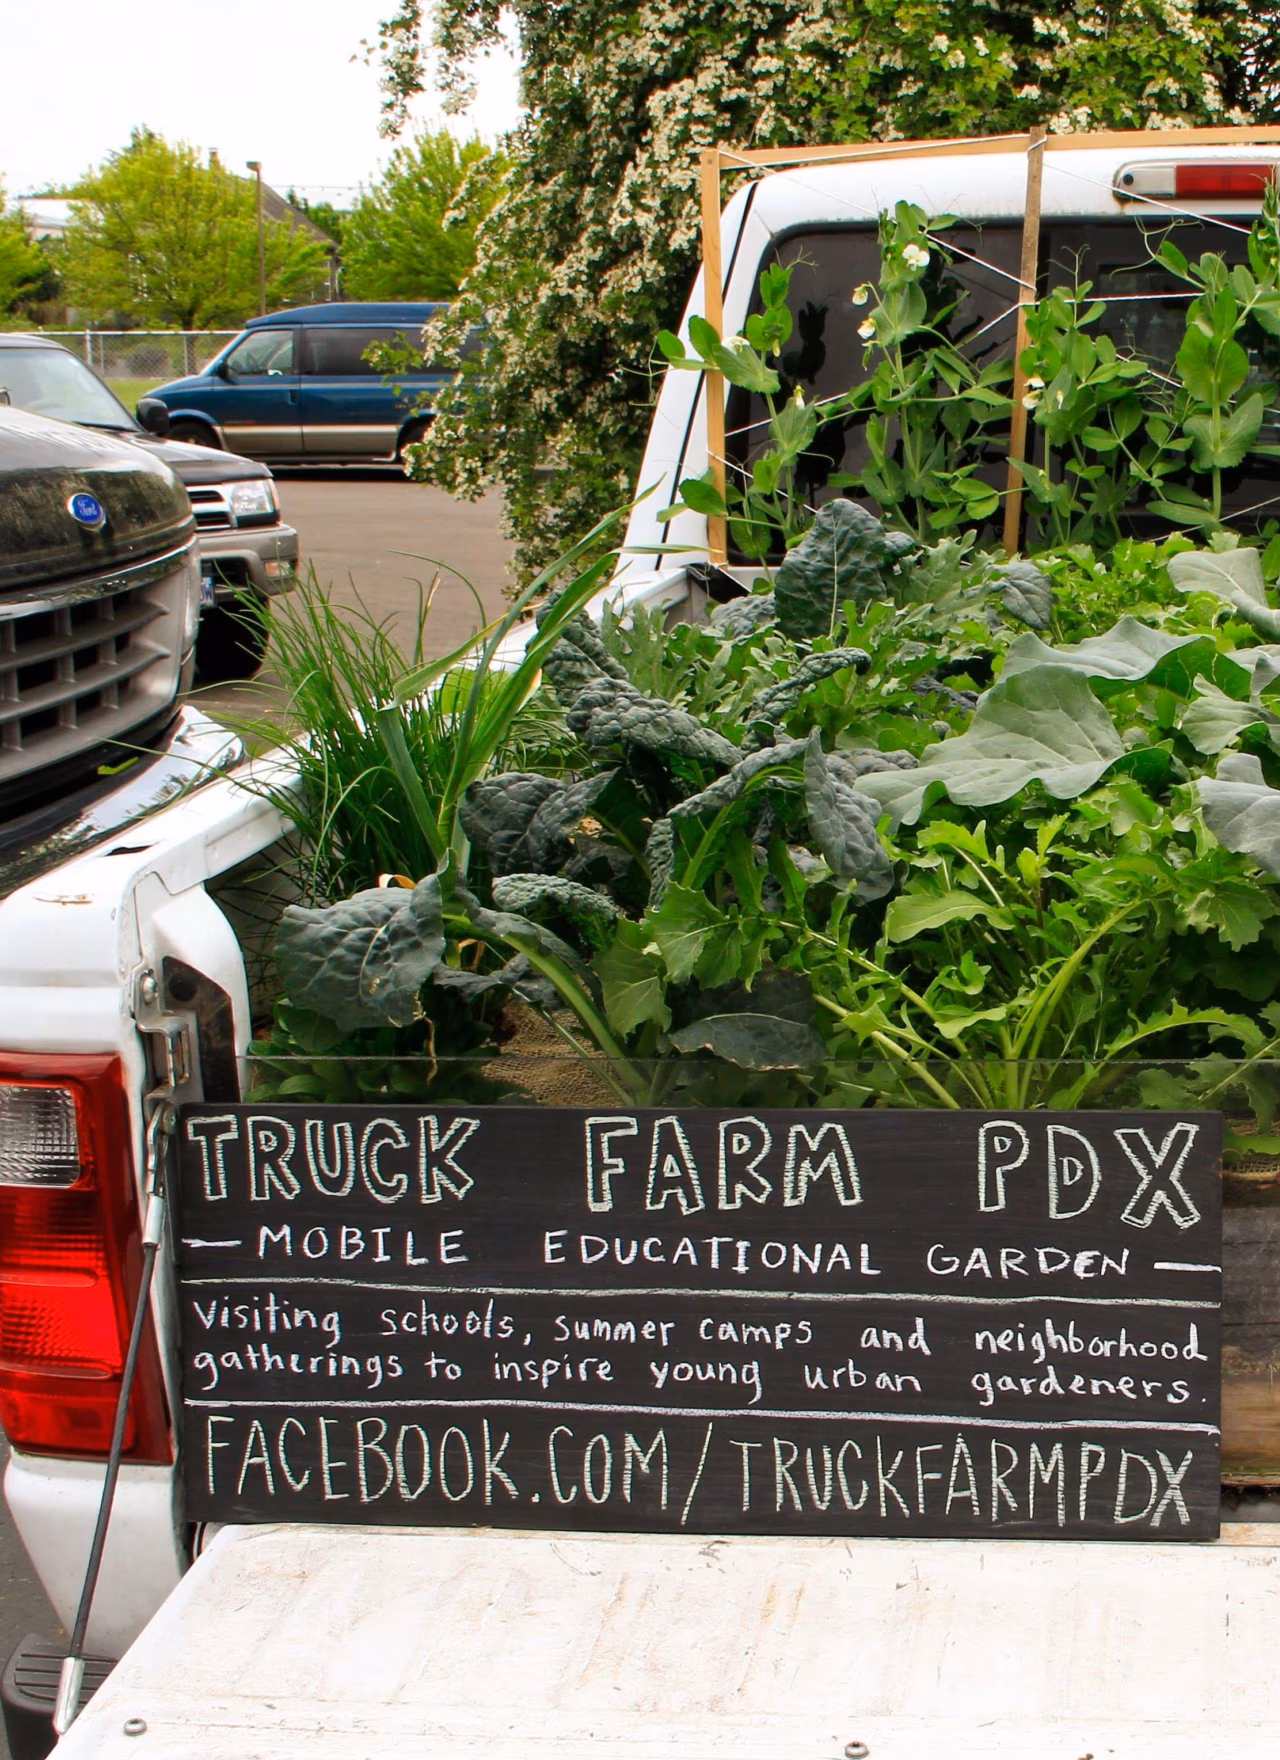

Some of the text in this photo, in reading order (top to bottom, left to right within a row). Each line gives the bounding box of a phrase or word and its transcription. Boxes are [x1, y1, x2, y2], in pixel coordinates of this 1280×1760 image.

[188, 1115, 1201, 1230] TRUCK FARM PDX
[258, 1225, 1130, 1280] MOBILE EDUCATIONAL GARDEN
[380, 1298, 531, 1346] schools,
[699, 1318, 812, 1350] camps
[861, 1317, 932, 1356] and
[976, 1319, 1208, 1364] neighborhood
[193, 1343, 1208, 1407] gatherings to inspire young urban gardeners.
